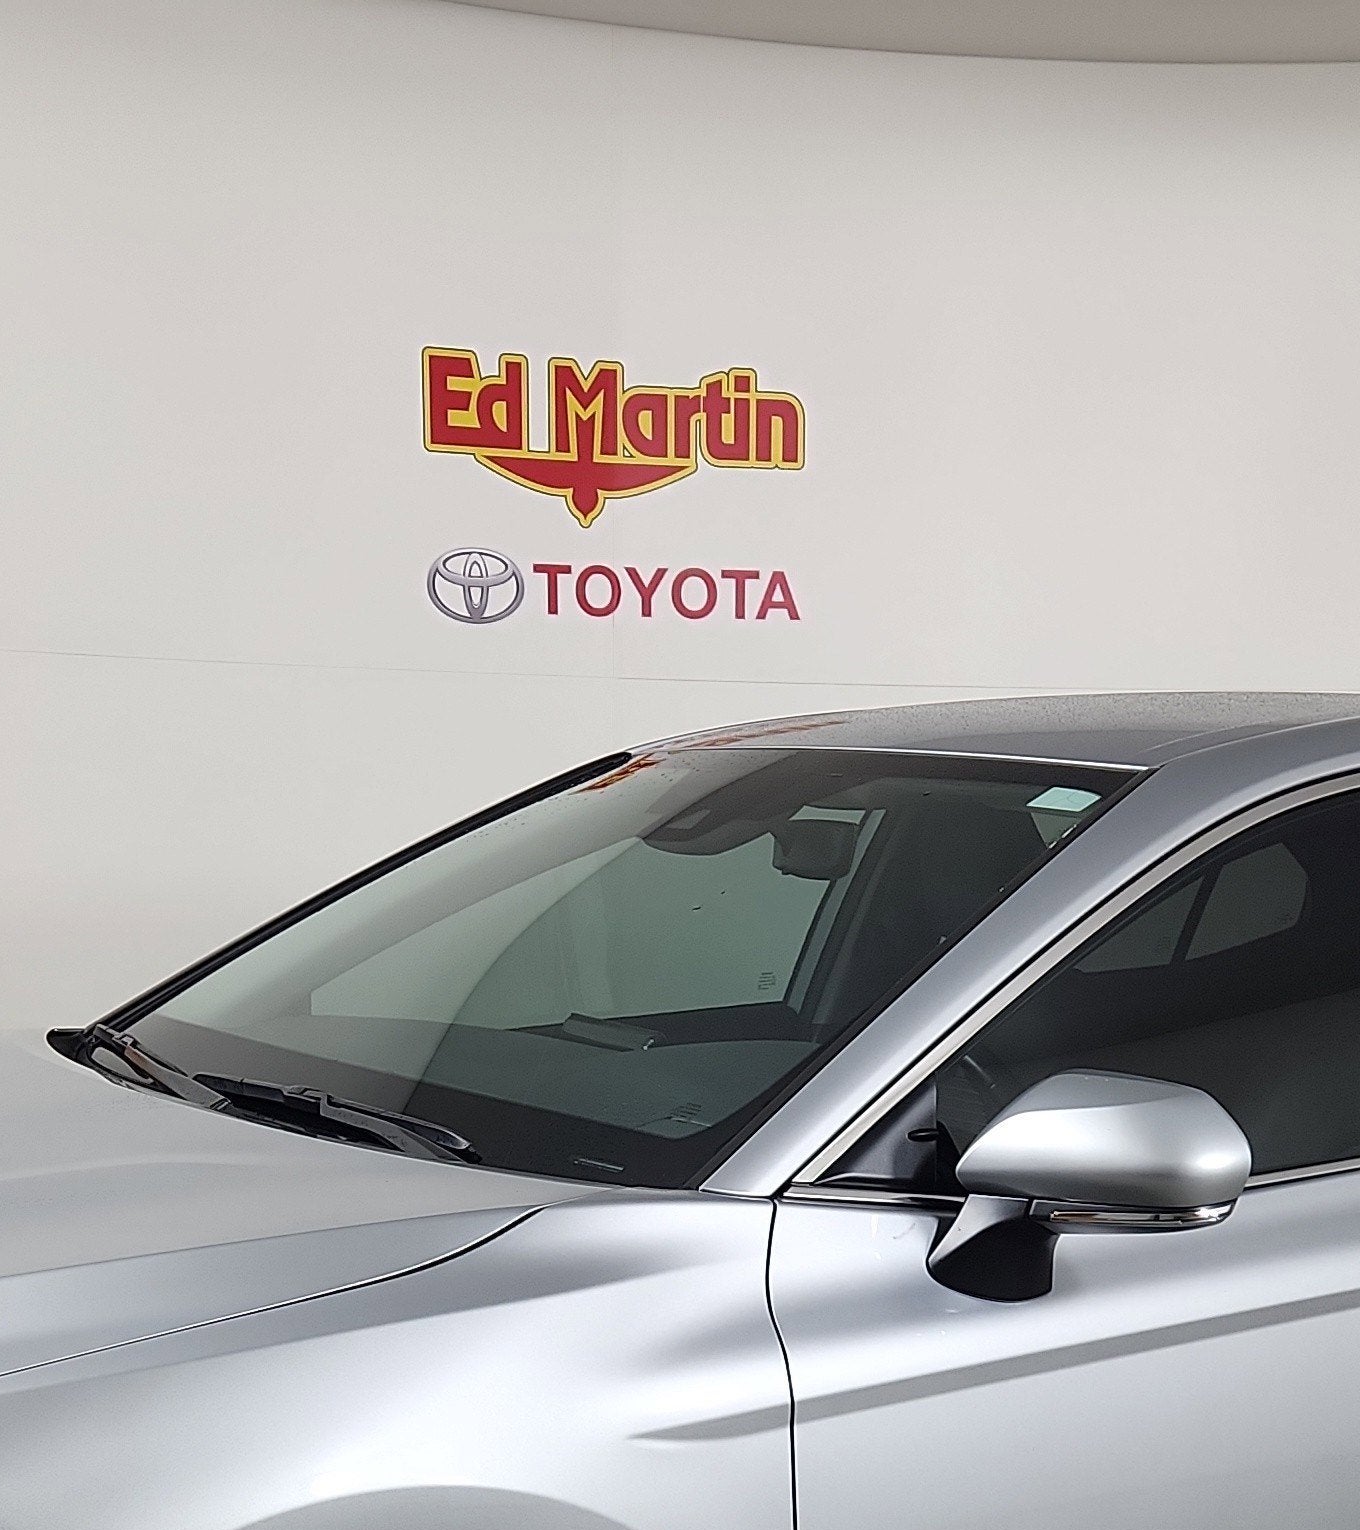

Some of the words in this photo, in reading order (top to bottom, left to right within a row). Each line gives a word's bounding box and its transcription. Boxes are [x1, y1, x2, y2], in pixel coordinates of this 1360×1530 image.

[423, 347, 528, 452] Ed
[549, 358, 805, 470] Martin
[533, 563, 800, 621] TOYOTA
